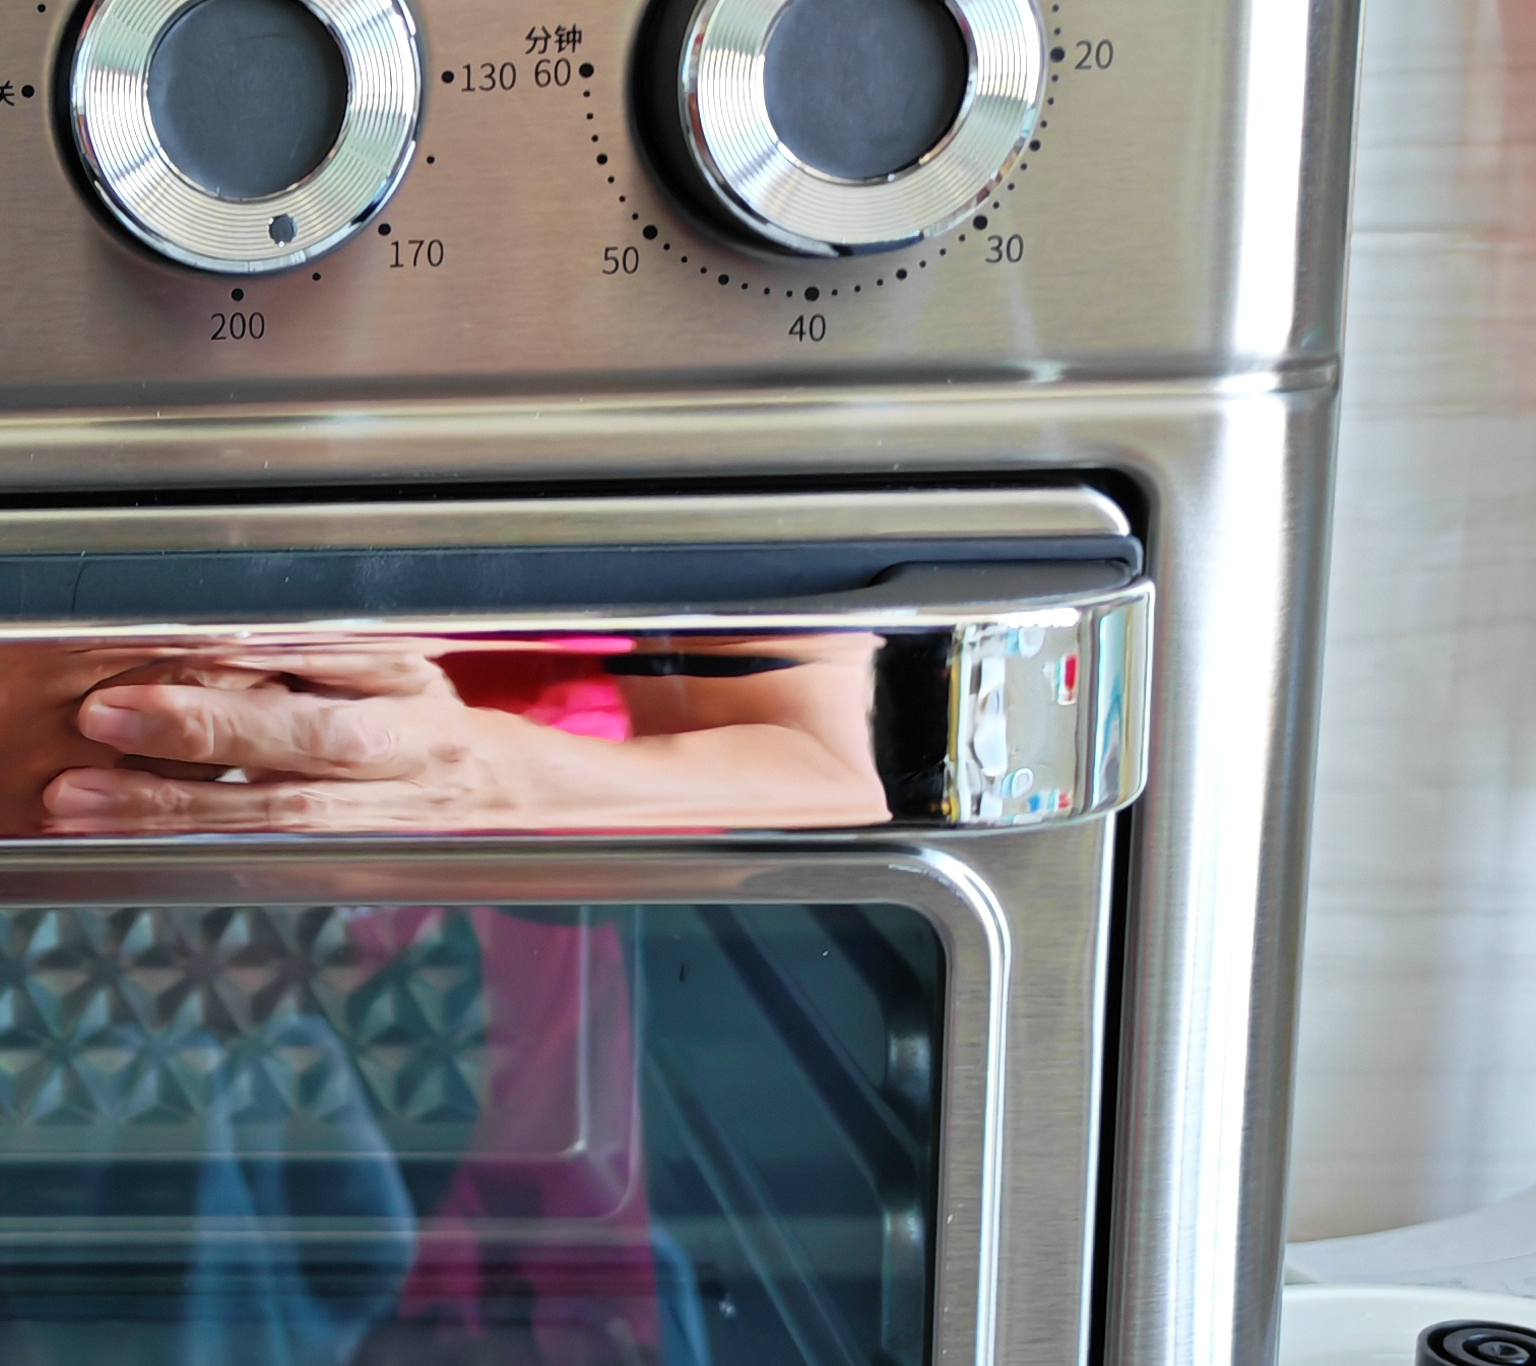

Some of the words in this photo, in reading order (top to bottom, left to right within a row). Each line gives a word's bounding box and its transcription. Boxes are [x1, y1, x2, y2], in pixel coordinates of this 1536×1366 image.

[524, 25, 583, 55] 分钟
[1074, 41, 1114, 71] 20
[460, 63, 517, 93] 130
[533, 59, 572, 89] 60
[388, 240, 445, 269] 170
[601, 246, 640, 276] 50
[984, 235, 1024, 265] 30
[210, 312, 266, 341] 200
[787, 313, 828, 343] 40
